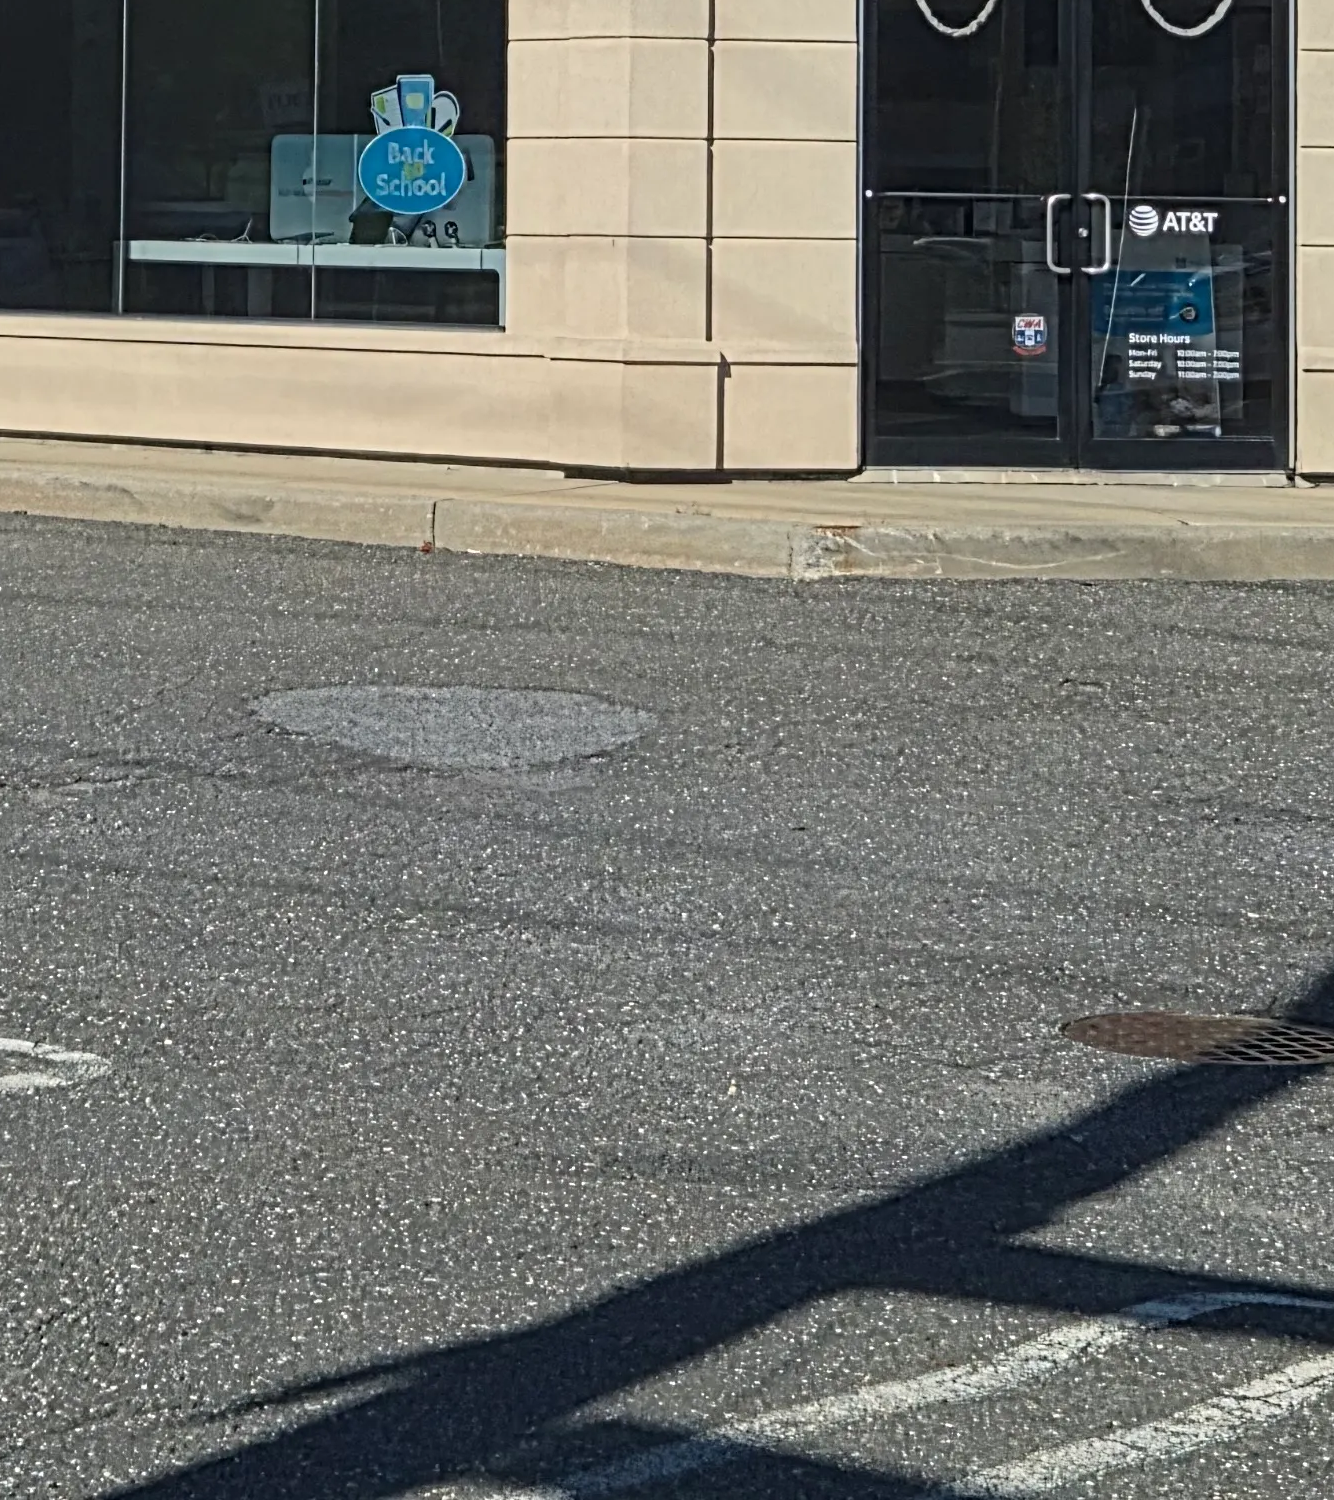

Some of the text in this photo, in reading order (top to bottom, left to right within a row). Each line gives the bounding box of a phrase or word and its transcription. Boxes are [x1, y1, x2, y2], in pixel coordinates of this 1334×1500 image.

[387, 138, 435, 165] Back
[376, 171, 447, 197] School
[1162, 211, 1219, 232] AT&T
[1128, 332, 1191, 344] Store Hours
